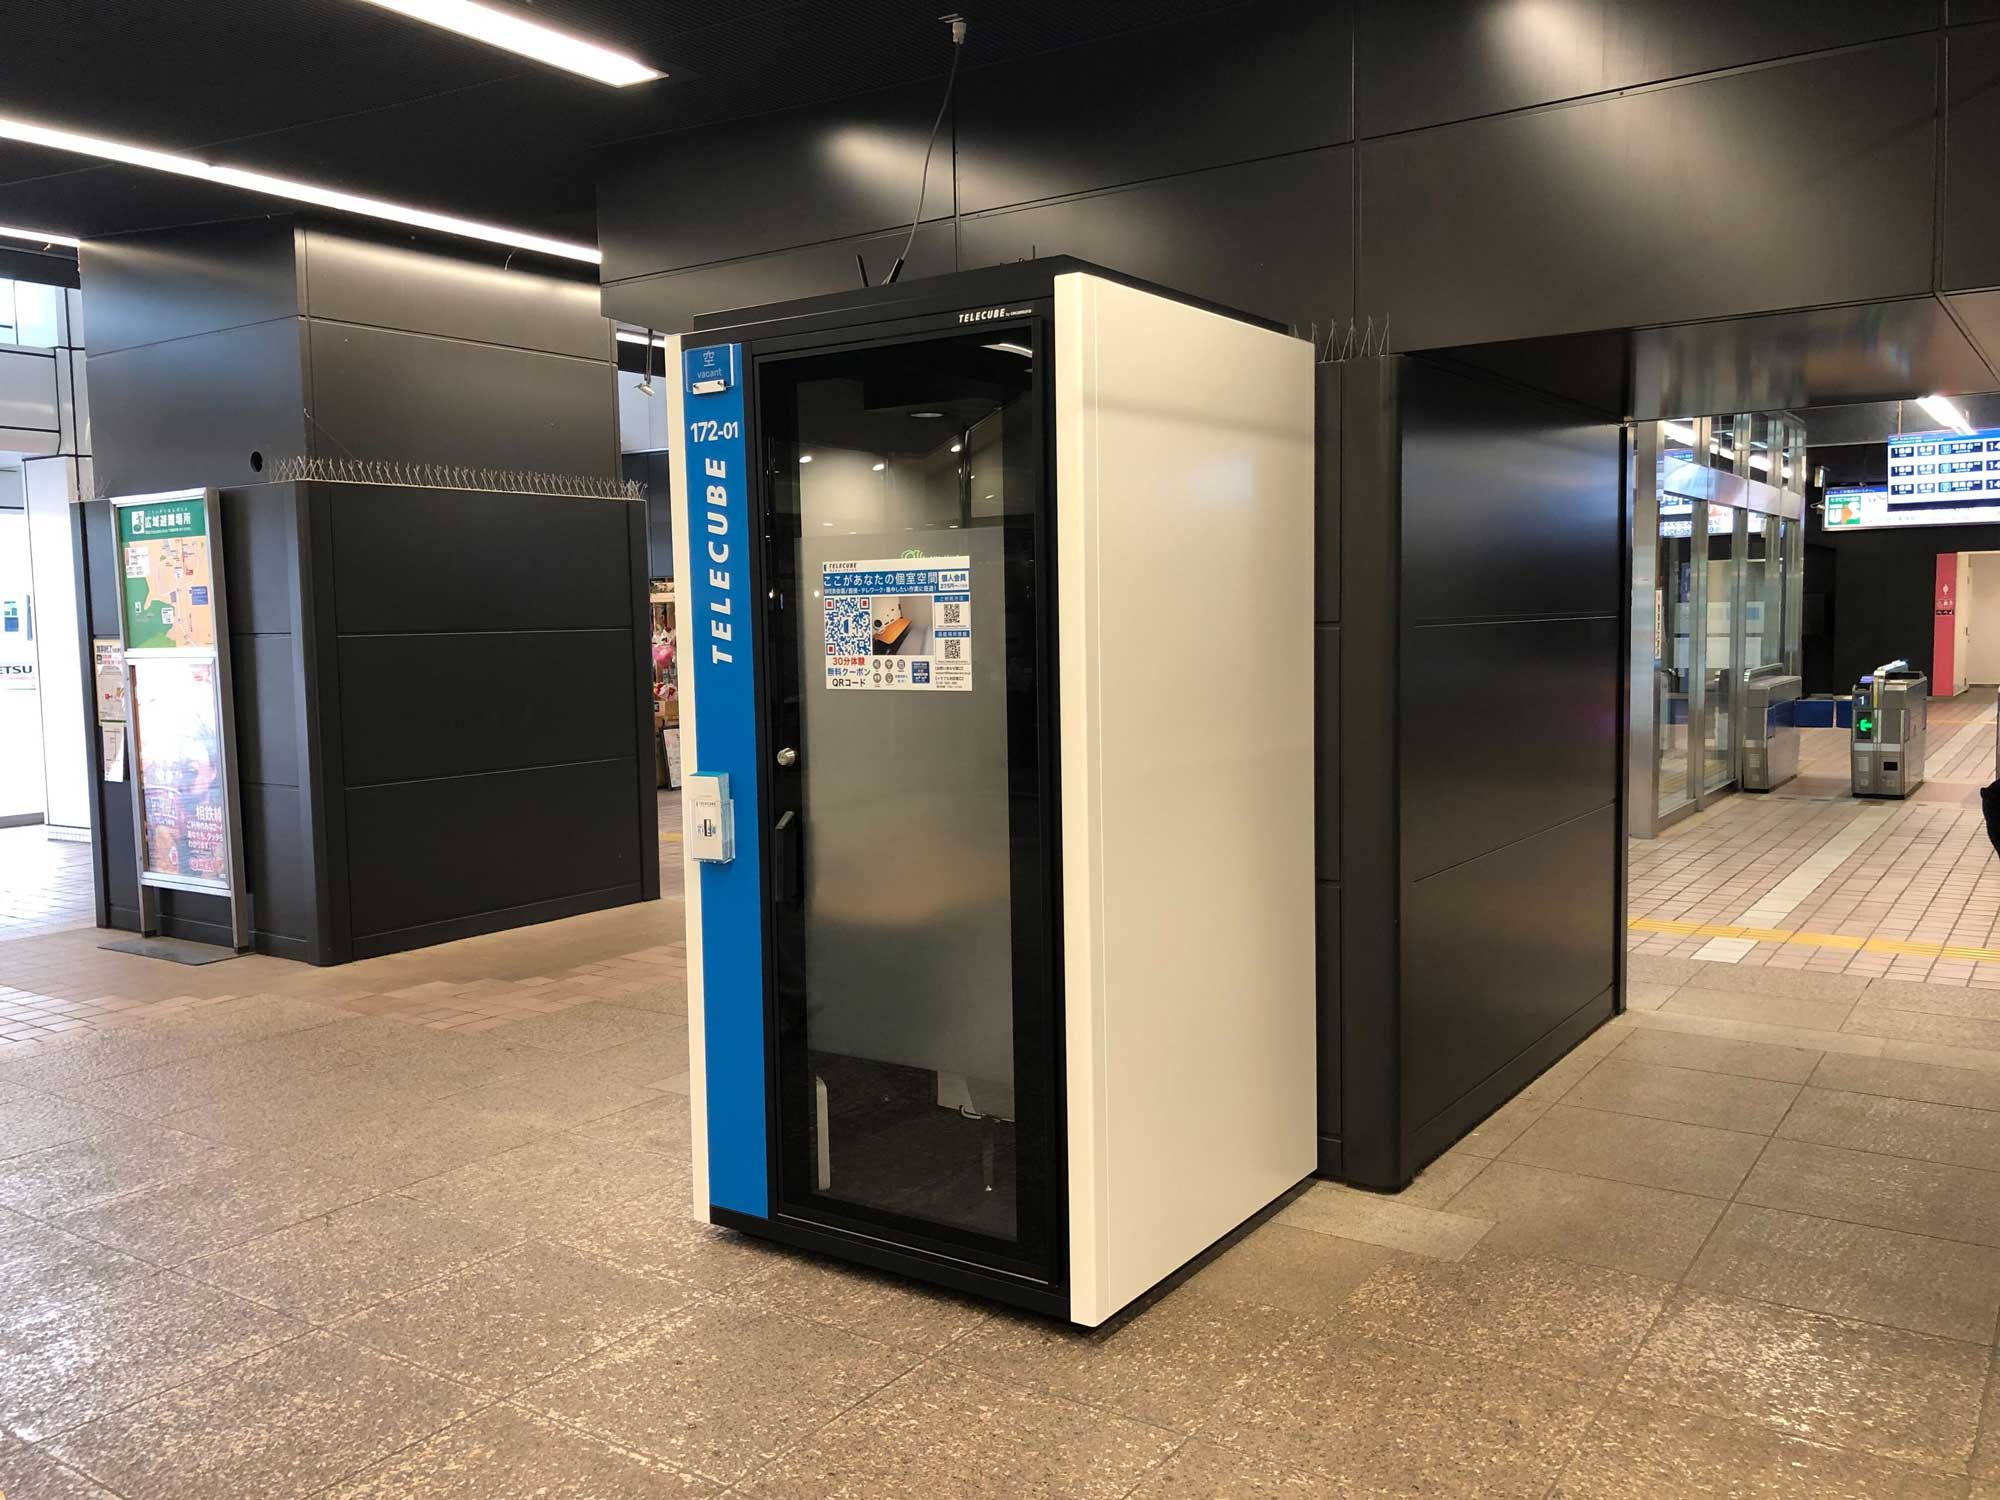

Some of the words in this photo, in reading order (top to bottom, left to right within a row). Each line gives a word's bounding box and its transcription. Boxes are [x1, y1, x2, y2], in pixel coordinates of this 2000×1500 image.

[958, 308, 1006, 323] TELECUBE
[697, 368, 722, 379] vacant
[690, 420, 738, 443] 172-01
[704, 458, 733, 665] TELECUBE
[824, 572, 938, 586] ここがあなたの個室空間
[832, 656, 865, 666] 30分体験
[827, 667, 871, 677] 無料クーポン
[832, 678, 866, 687] QRコード
[1859, 696, 1865, 705] 1
